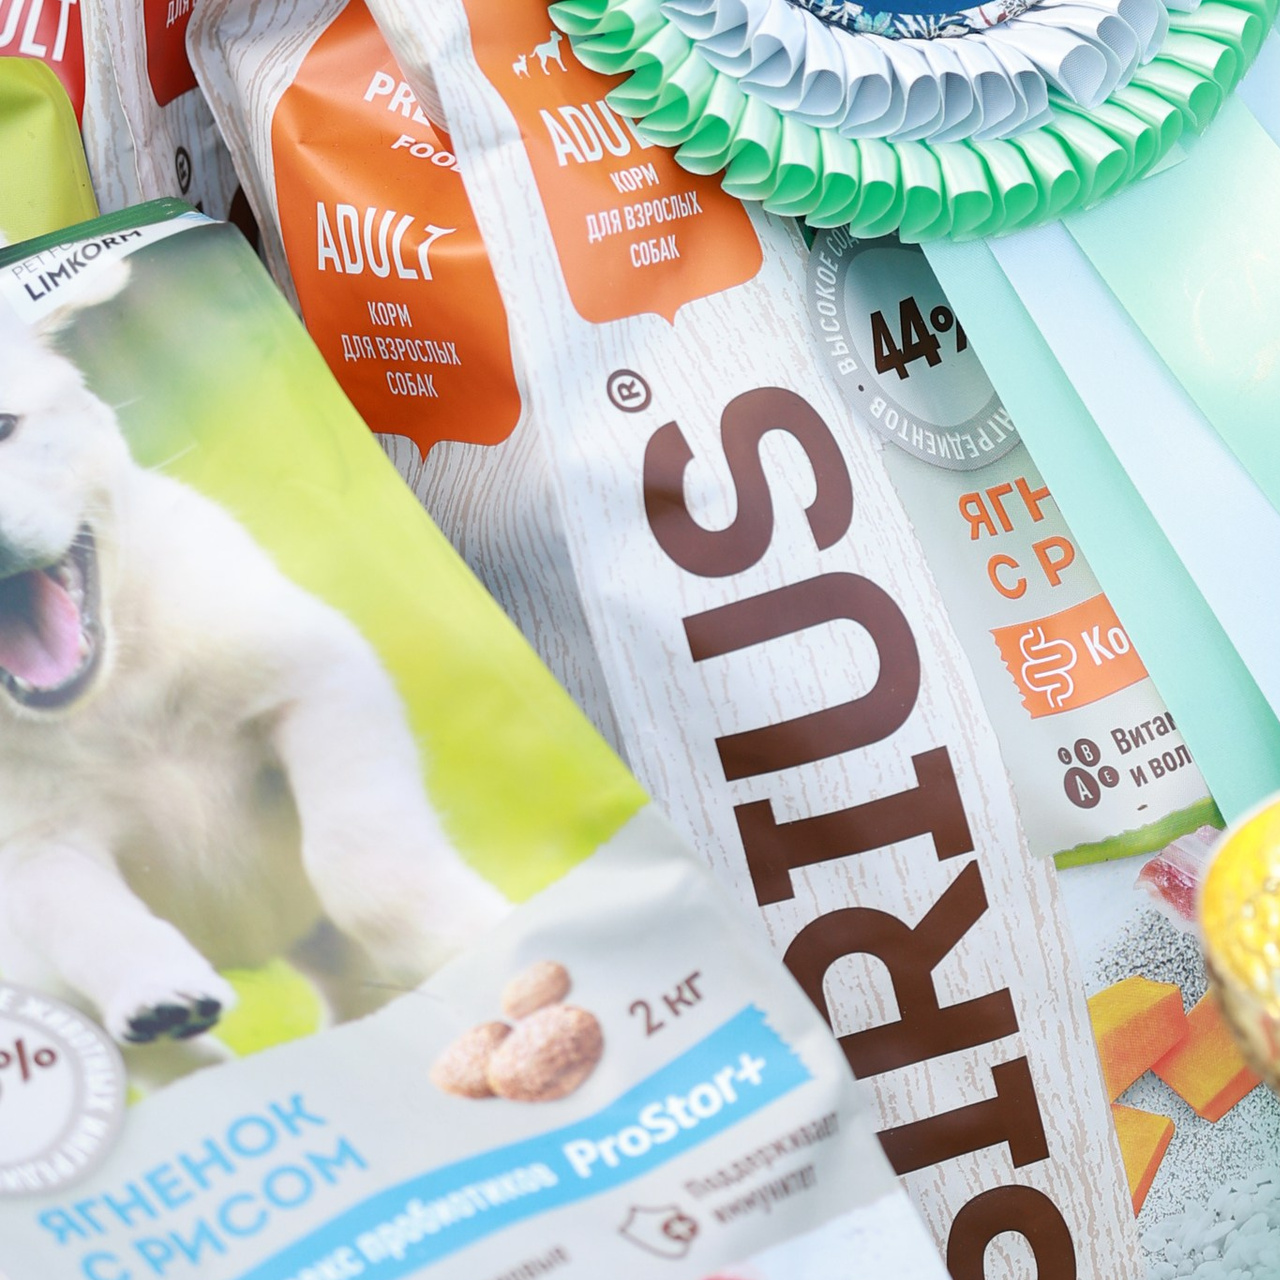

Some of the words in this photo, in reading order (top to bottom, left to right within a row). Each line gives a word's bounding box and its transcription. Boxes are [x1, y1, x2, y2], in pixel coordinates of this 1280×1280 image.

[539, 99, 656, 167] ADUL
[609, 162, 660, 194] КОРМ
[316, 200, 458, 282] ADULT
[585, 208, 623, 245] ДЛЯ
[623, 190, 704, 231] ВЗРОСЛЫХ
[11, 254, 46, 281] PET
[23, 230, 143, 302] LIMKORM
[629, 234, 681, 268] СОБАК
[366, 300, 413, 329] КОРМ
[814, 252, 859, 376] ВЫСОКОЕ
[340, 333, 376, 363] ДЛЯ
[375, 336, 462, 367] ВЗРОСЛЫХ
[385, 370, 439, 399] СОБАК
[869, 395, 1016, 460] НГРЕДИЕНТОВ
[986, 553, 1029, 600] С
[1032, 535, 1075, 588] Р
[1081, 626, 1130, 667] Ко
[1129, 764, 1149, 788] и
[1147, 744, 1193, 780] вол
[628, 998, 665, 1038] 2
[562, 1051, 767, 1180] ProStor+
[36, 1093, 328, 1246] ЯГНЕНОК
[133, 1134, 370, 1276] РИСОМ
